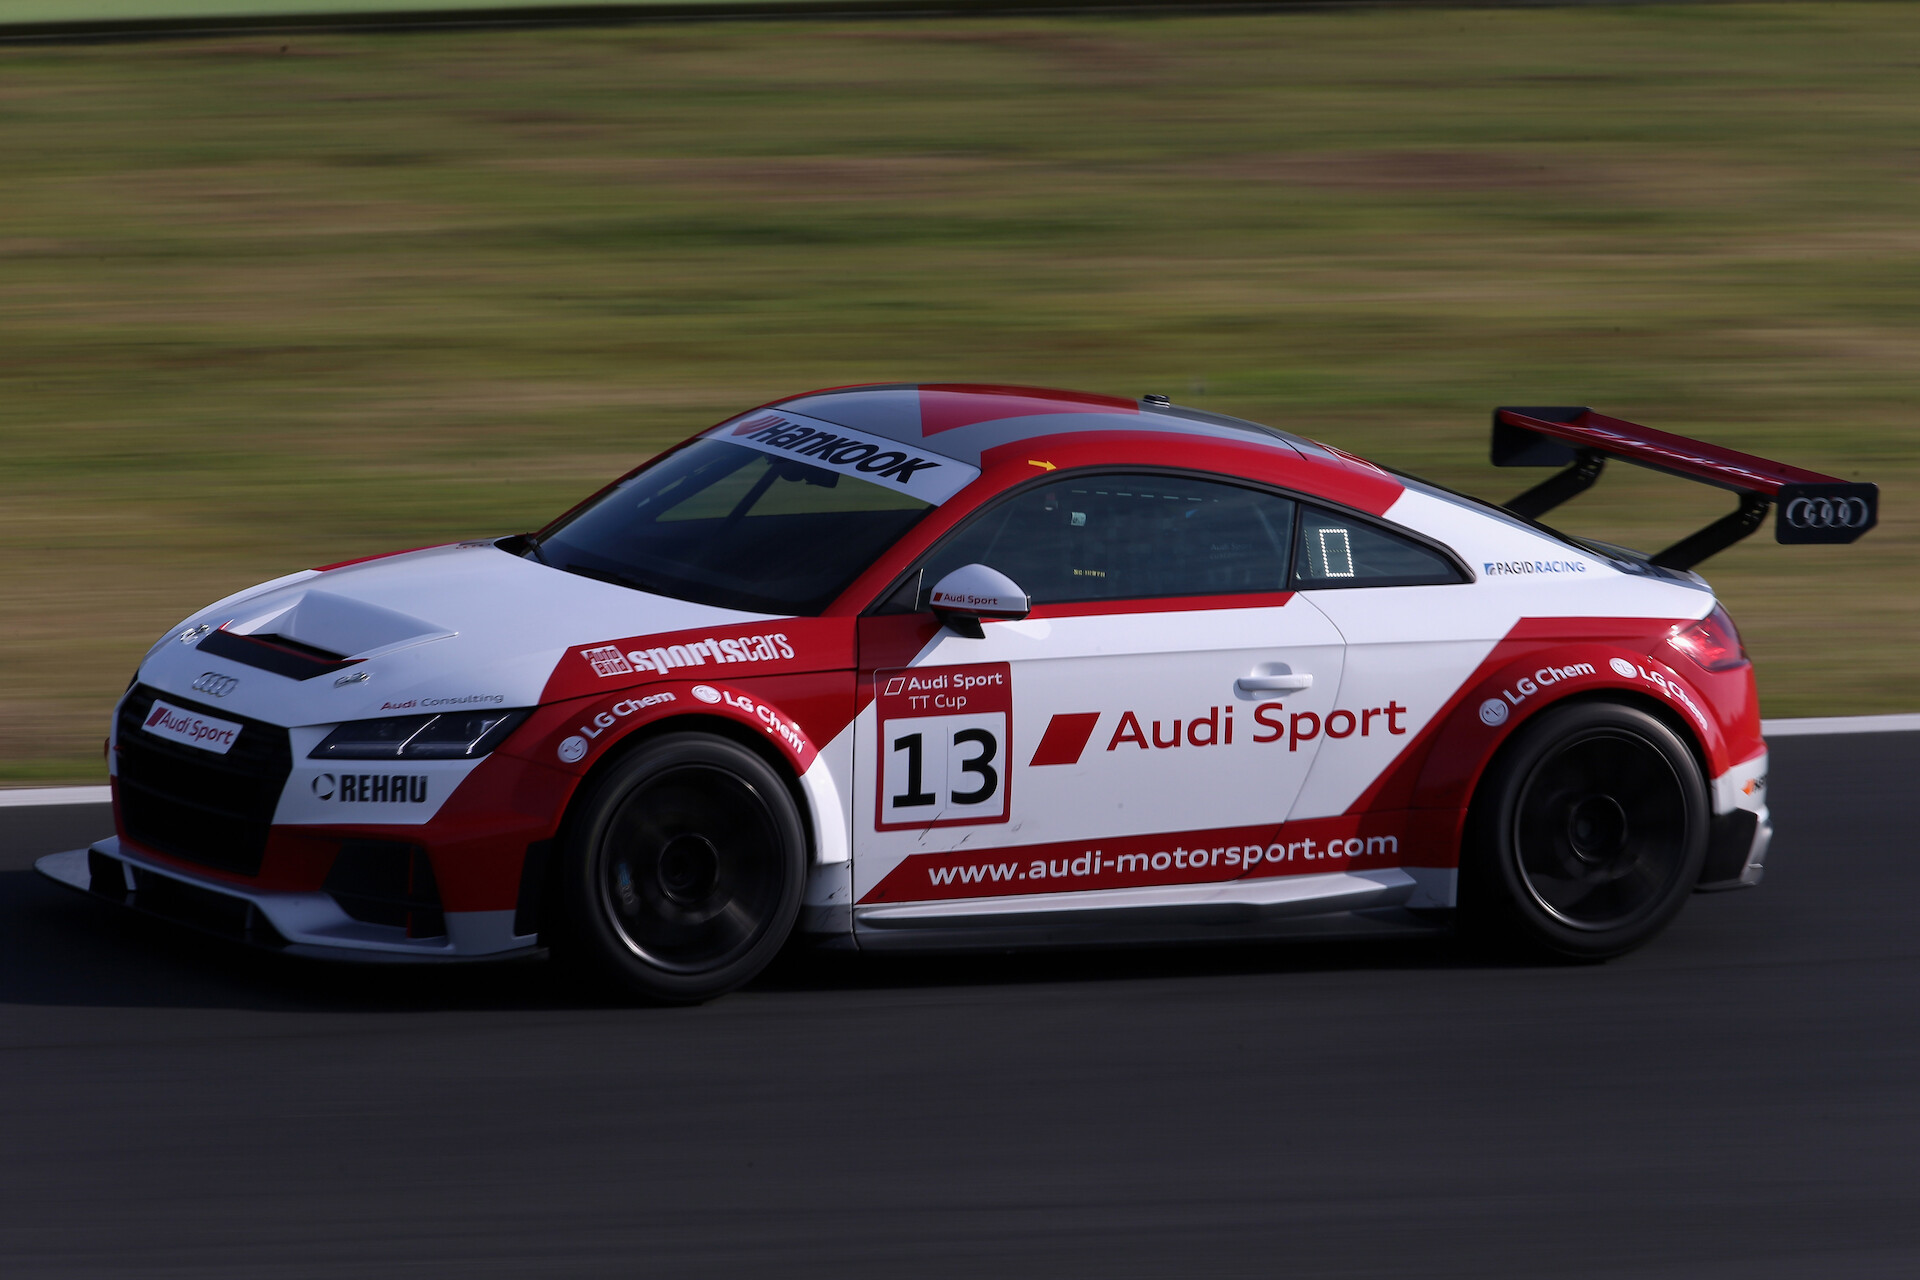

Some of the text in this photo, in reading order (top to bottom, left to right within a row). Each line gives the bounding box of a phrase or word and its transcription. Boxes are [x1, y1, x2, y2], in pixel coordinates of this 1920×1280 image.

[944, 593, 998, 605] Audi Sport
[908, 672, 1003, 691] Audi Sport
[1502, 662, 1597, 706] LG Chem
[1637, 664, 1668, 689] LG
[380, 693, 505, 710] Audi Consulting
[580, 691, 676, 739] LG Chem
[908, 695, 967, 710] TT Cup
[159, 711, 234, 745] Audi Sport
[723, 690, 805, 754] LG Chem
[1106, 700, 1407, 752] Audi Sport
[893, 727, 998, 808] 13
[339, 774, 428, 803] REHAU
[928, 834, 1398, 886] www.audi-motorsport.com
